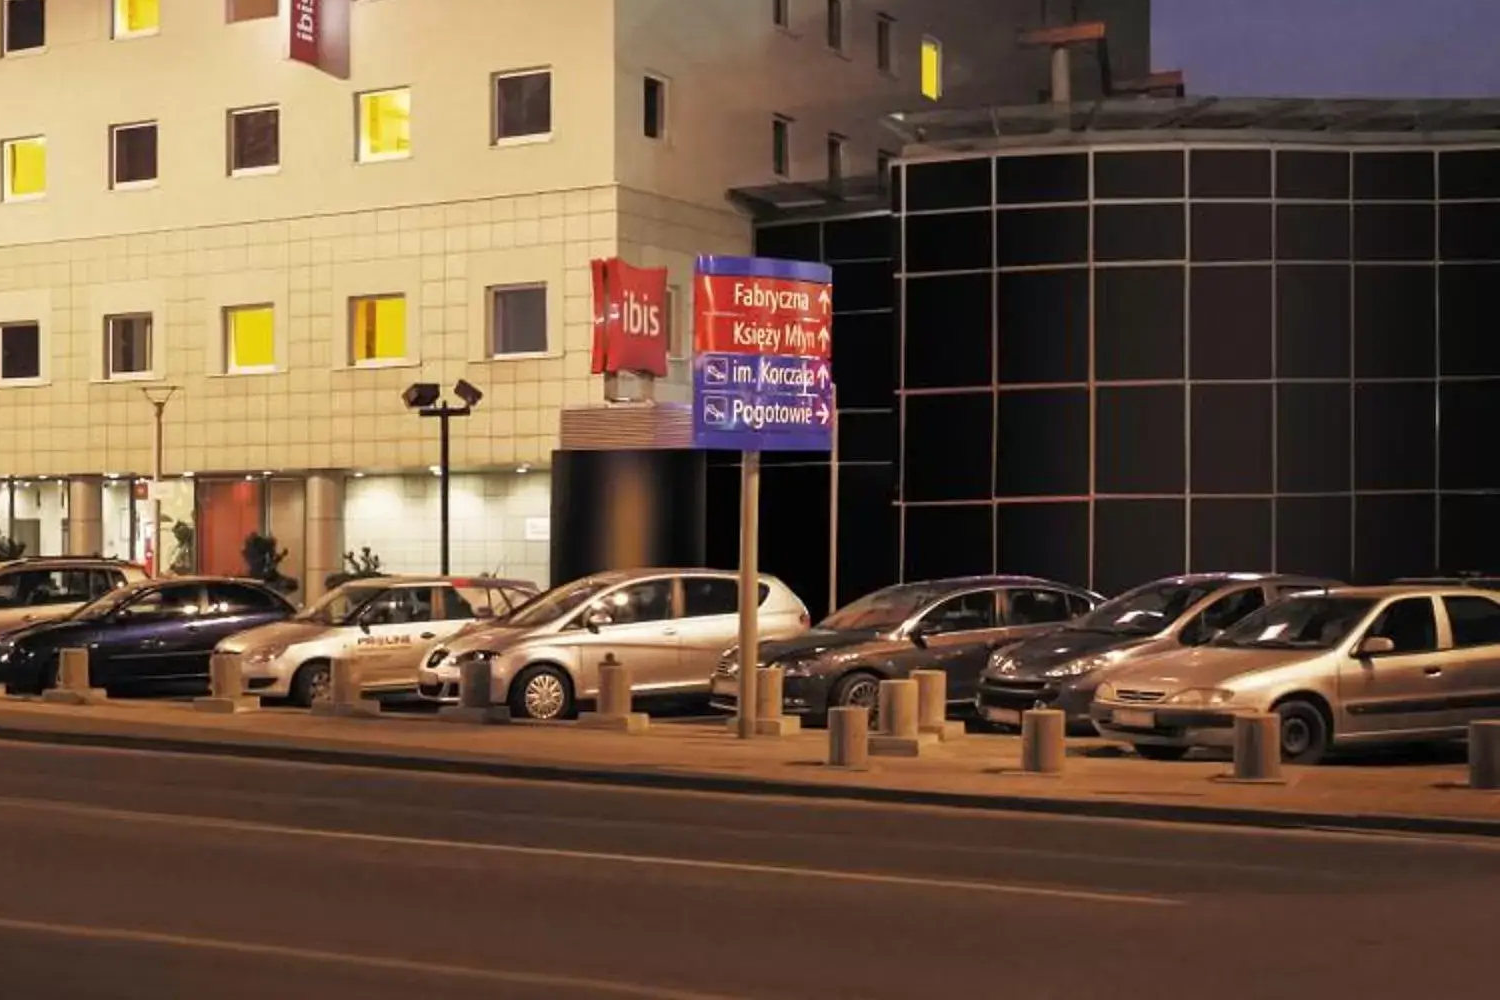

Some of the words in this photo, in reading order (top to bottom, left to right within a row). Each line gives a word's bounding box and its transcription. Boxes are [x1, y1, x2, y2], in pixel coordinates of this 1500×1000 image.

[623, 289, 659, 336] ibis
[735, 283, 809, 314] Fabryczna
[733, 322, 780, 352] Księży
[785, 324, 815, 353] Młyn
[733, 360, 756, 383] im.
[733, 400, 812, 429] Pogotowie
